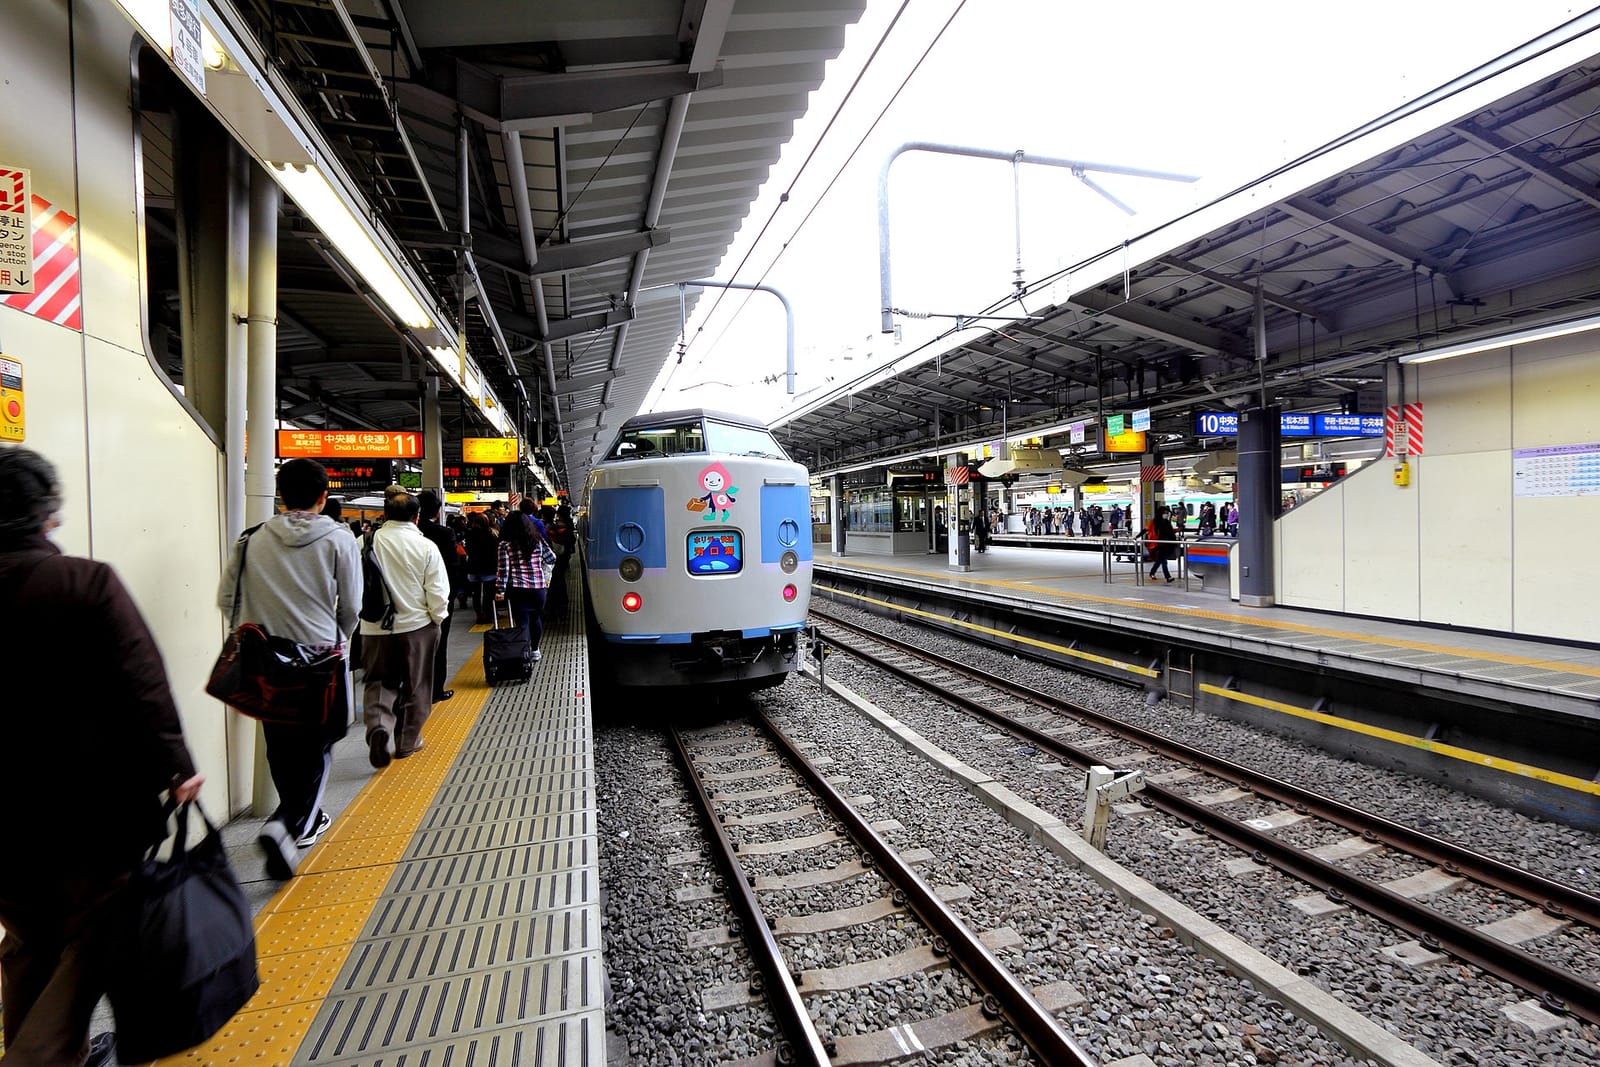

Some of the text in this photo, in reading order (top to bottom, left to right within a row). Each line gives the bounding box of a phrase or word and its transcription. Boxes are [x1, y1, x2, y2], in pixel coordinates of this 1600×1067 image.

[6, 250, 26, 258] stop
[1199, 415, 1219, 433] 10
[393, 434, 416, 455] 11
